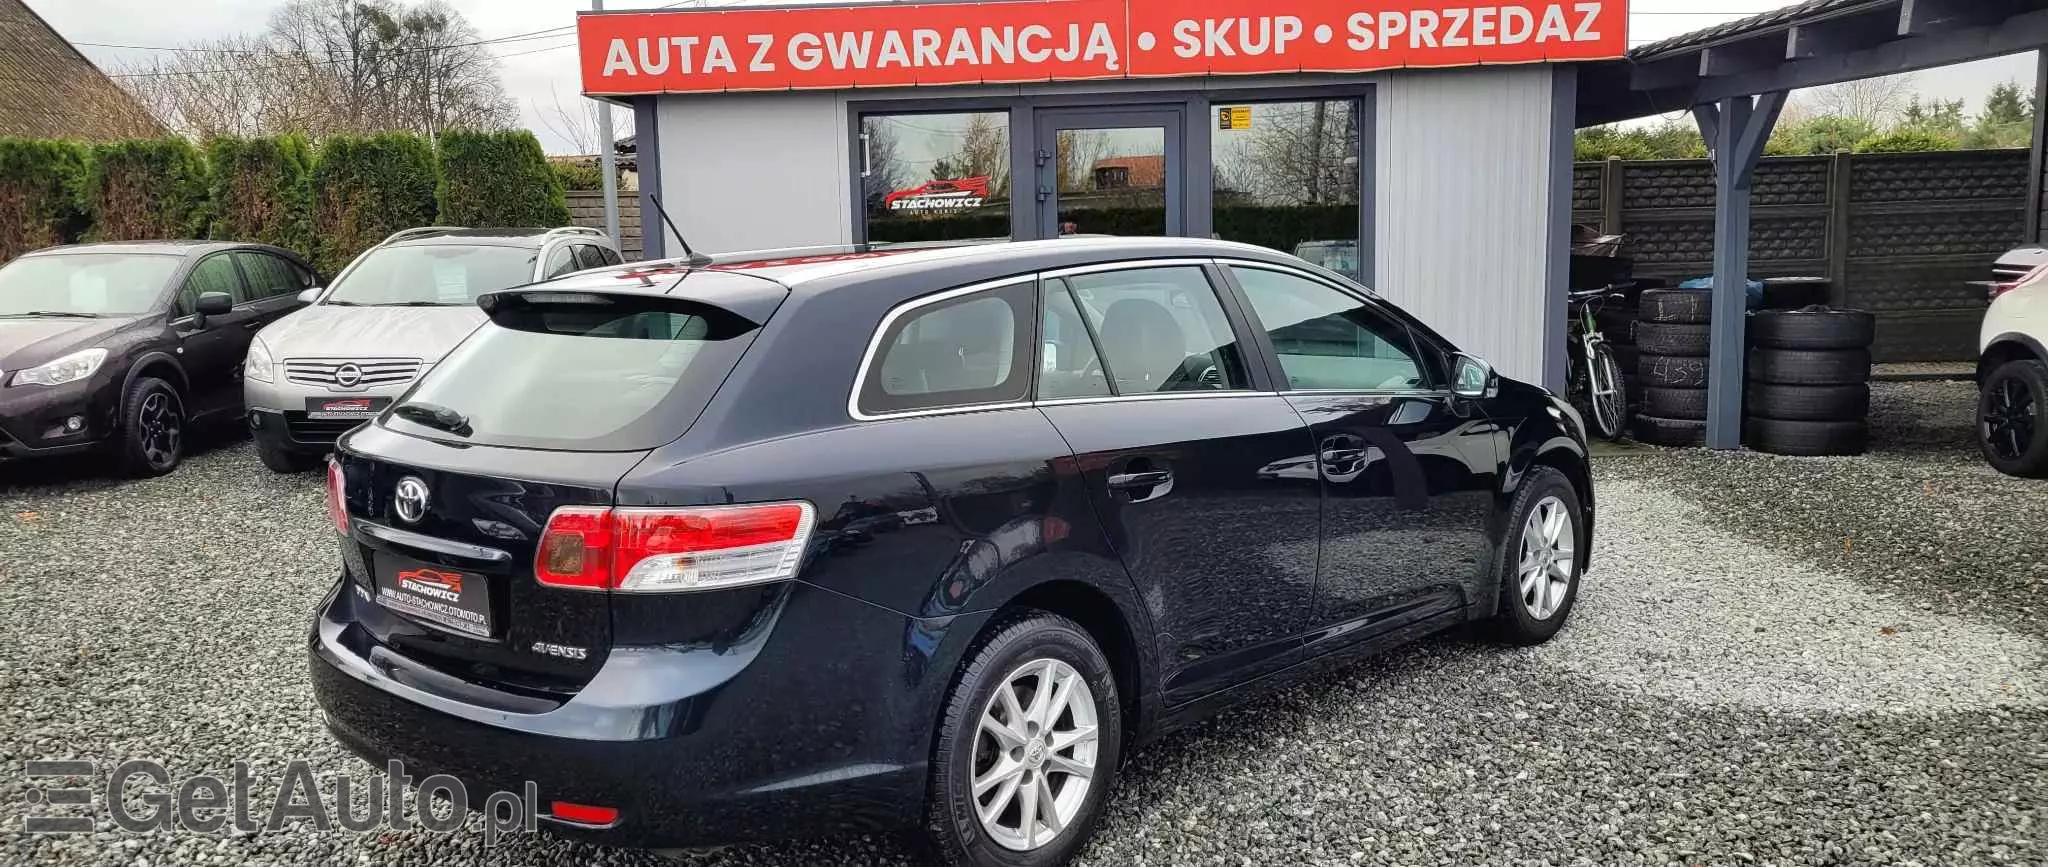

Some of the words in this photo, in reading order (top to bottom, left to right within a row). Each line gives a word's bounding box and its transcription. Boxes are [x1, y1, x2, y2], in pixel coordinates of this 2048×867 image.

[602, 35, 737, 78] AUTA
[747, 34, 776, 72] Z
[787, 21, 1119, 72] GWARANCJĄ
[1173, 15, 1303, 58] SKUP
[1346, 2, 1602, 51] SPRZEDAZ
[890, 198, 983, 210] STACHOWICZ
[401, 579, 461, 603] STACHOWICZ
[380, 586, 488, 625] WWW.AUTO-STACHOWICZ.OTOMOTO.PL
[531, 642, 587, 660] AVENSIS
